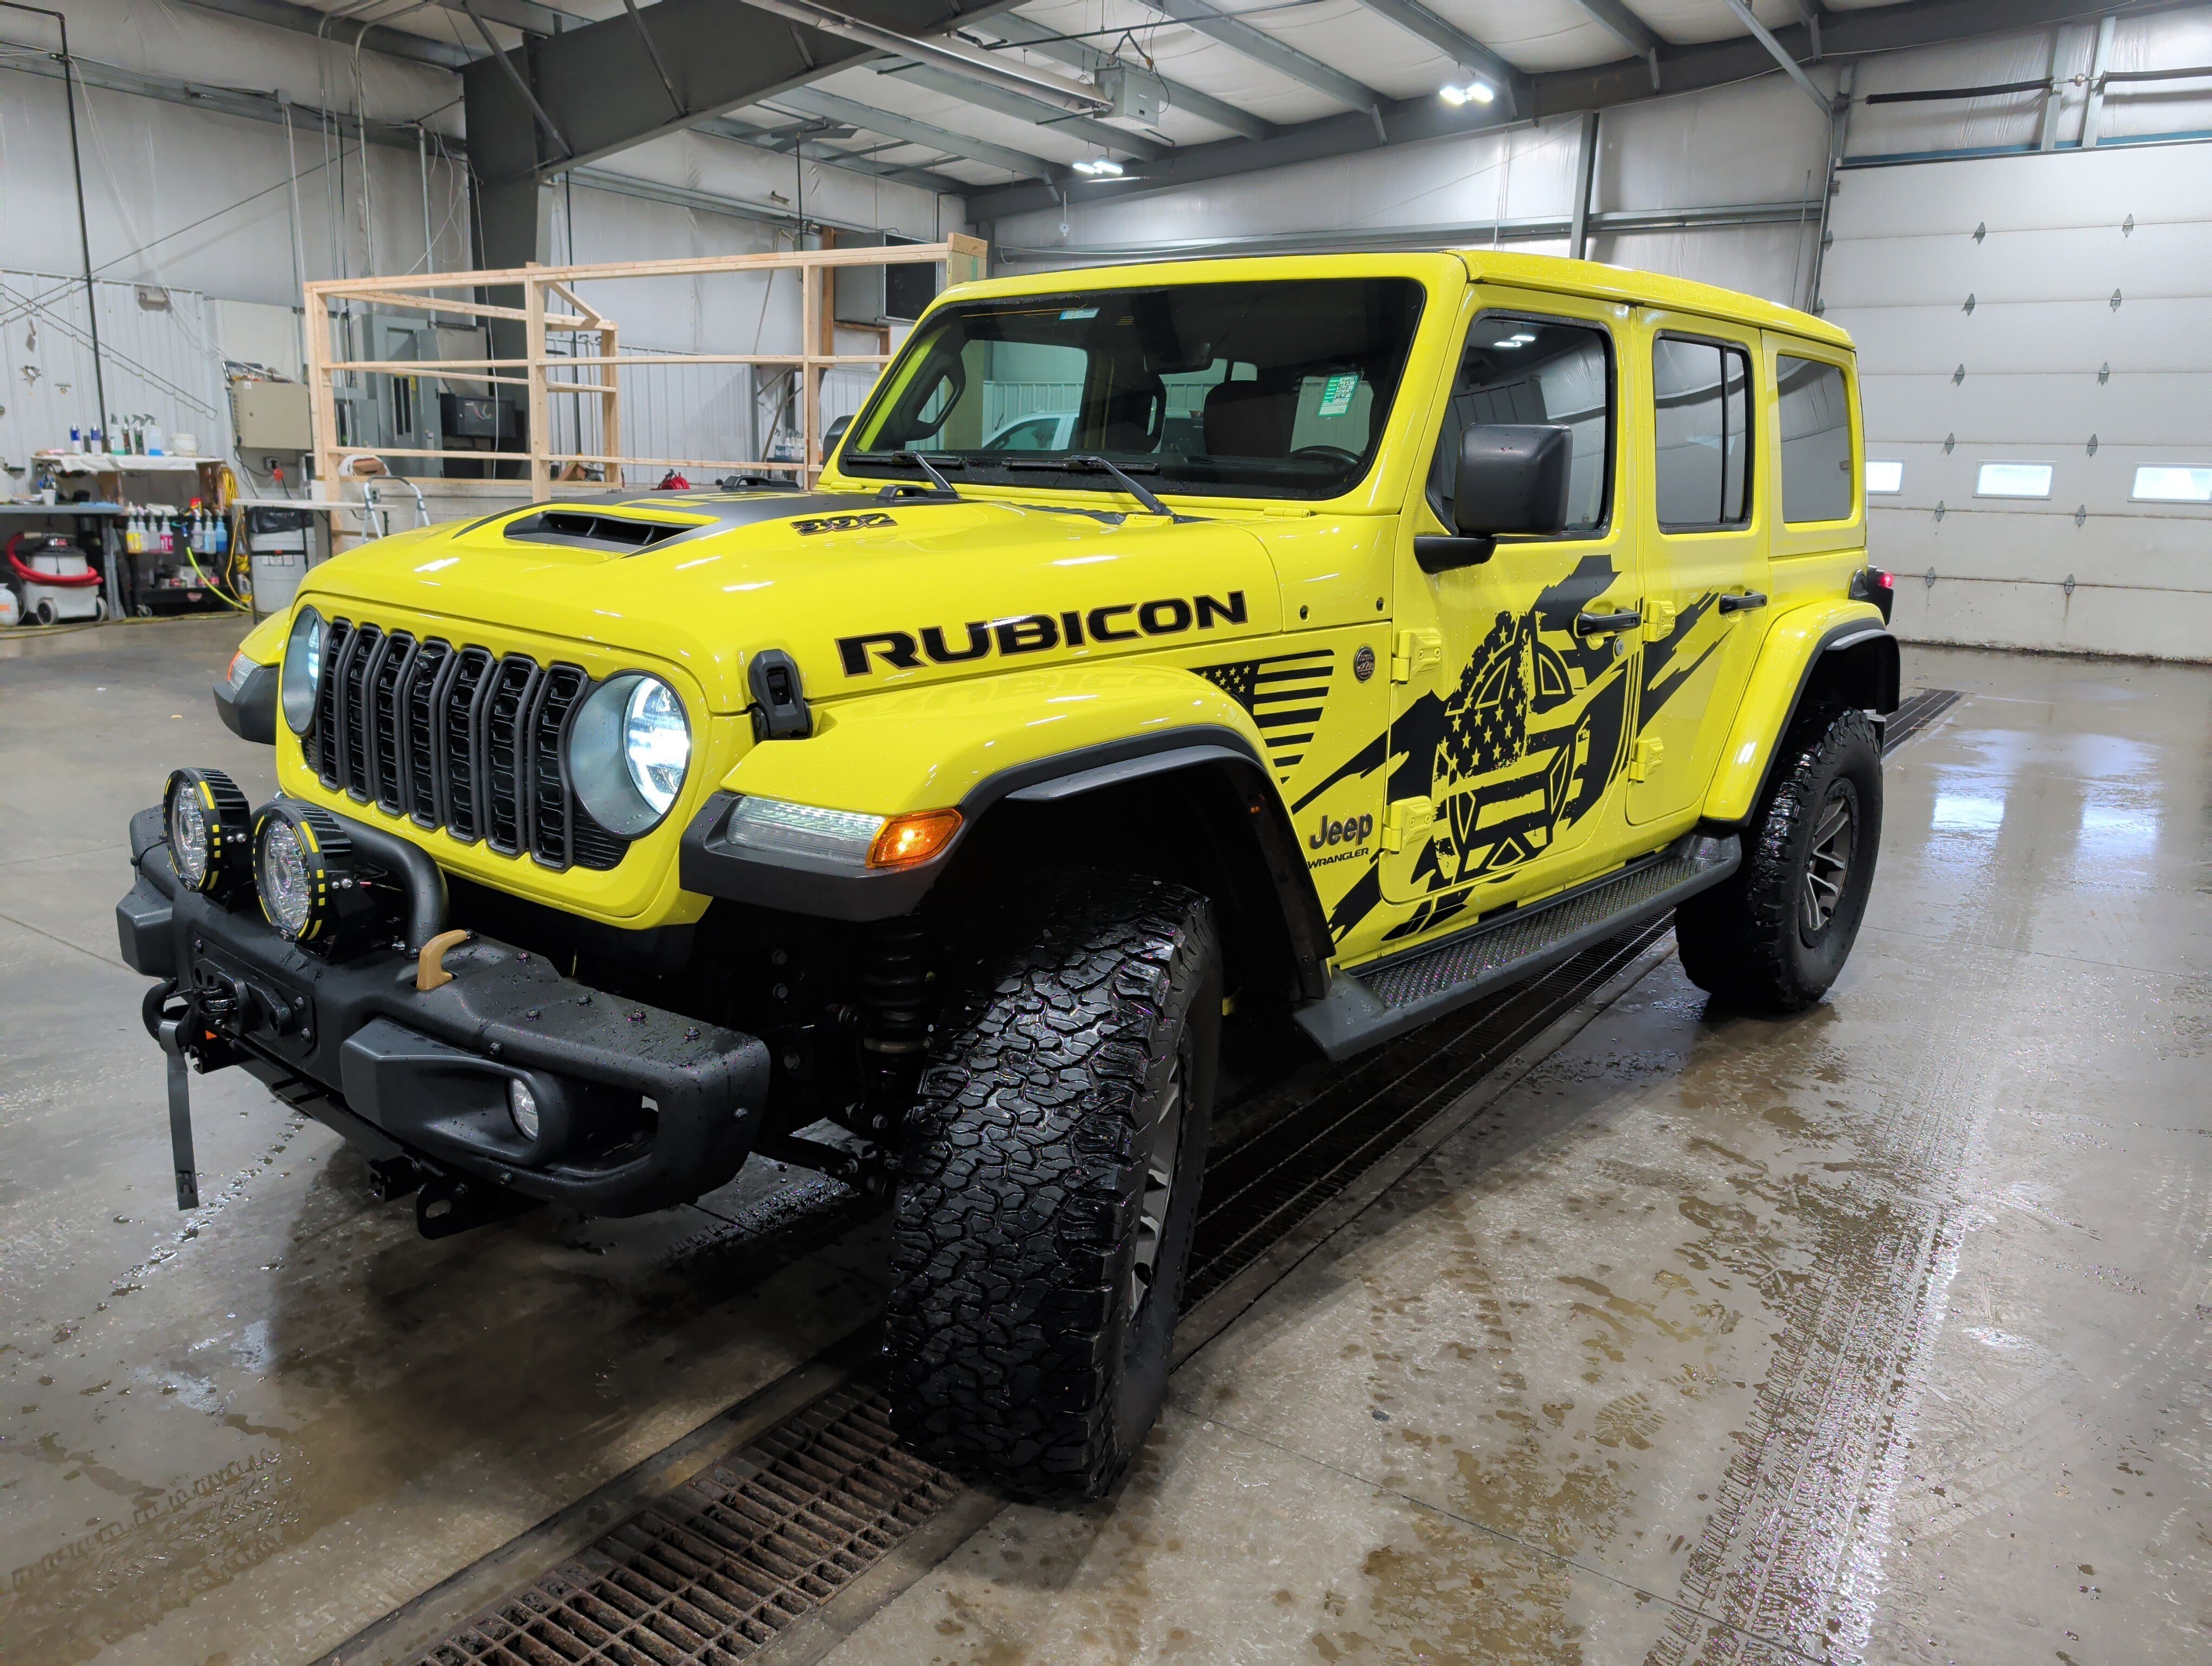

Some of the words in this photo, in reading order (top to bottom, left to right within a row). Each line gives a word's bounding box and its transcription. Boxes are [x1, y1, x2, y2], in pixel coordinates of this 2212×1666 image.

[790, 512, 898, 536] 392
[834, 590, 1248, 677] RUBICON
[1309, 813, 1373, 850] Jeep
[1307, 847, 1369, 869] WRANGLER
